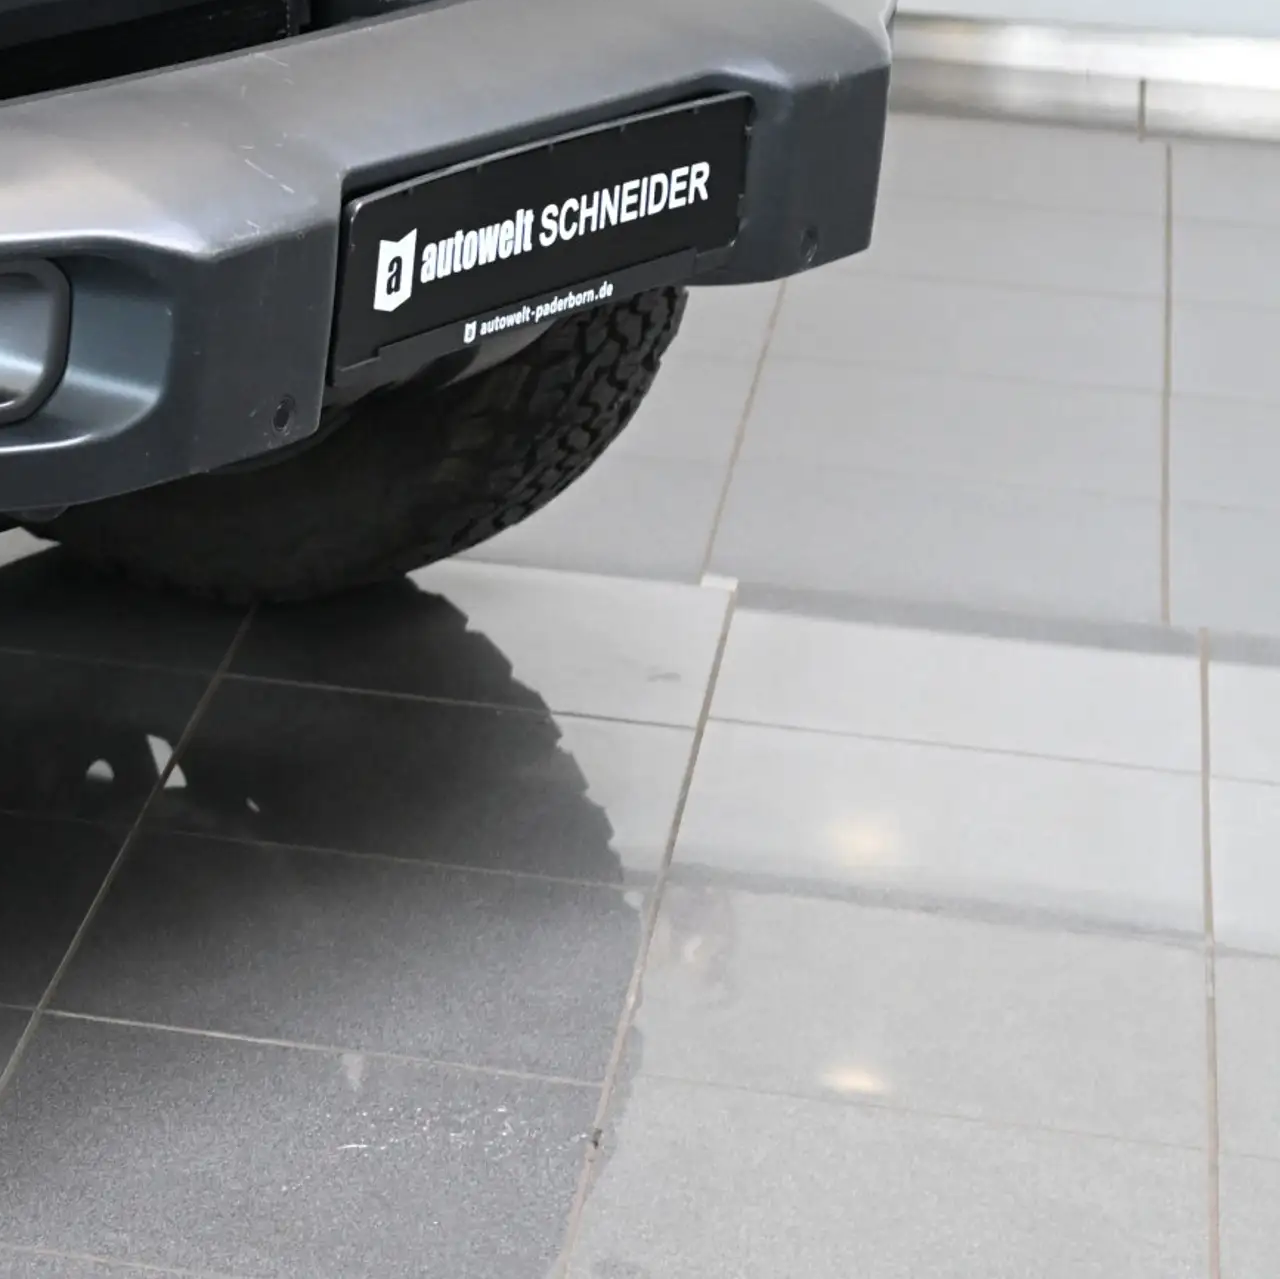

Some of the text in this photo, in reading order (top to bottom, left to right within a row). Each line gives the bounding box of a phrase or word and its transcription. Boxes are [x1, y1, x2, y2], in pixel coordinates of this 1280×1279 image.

[419, 208, 535, 284] autowelt
[539, 161, 711, 247] SCHNEIDER
[480, 280, 614, 336] autowelt-paderborn.de
